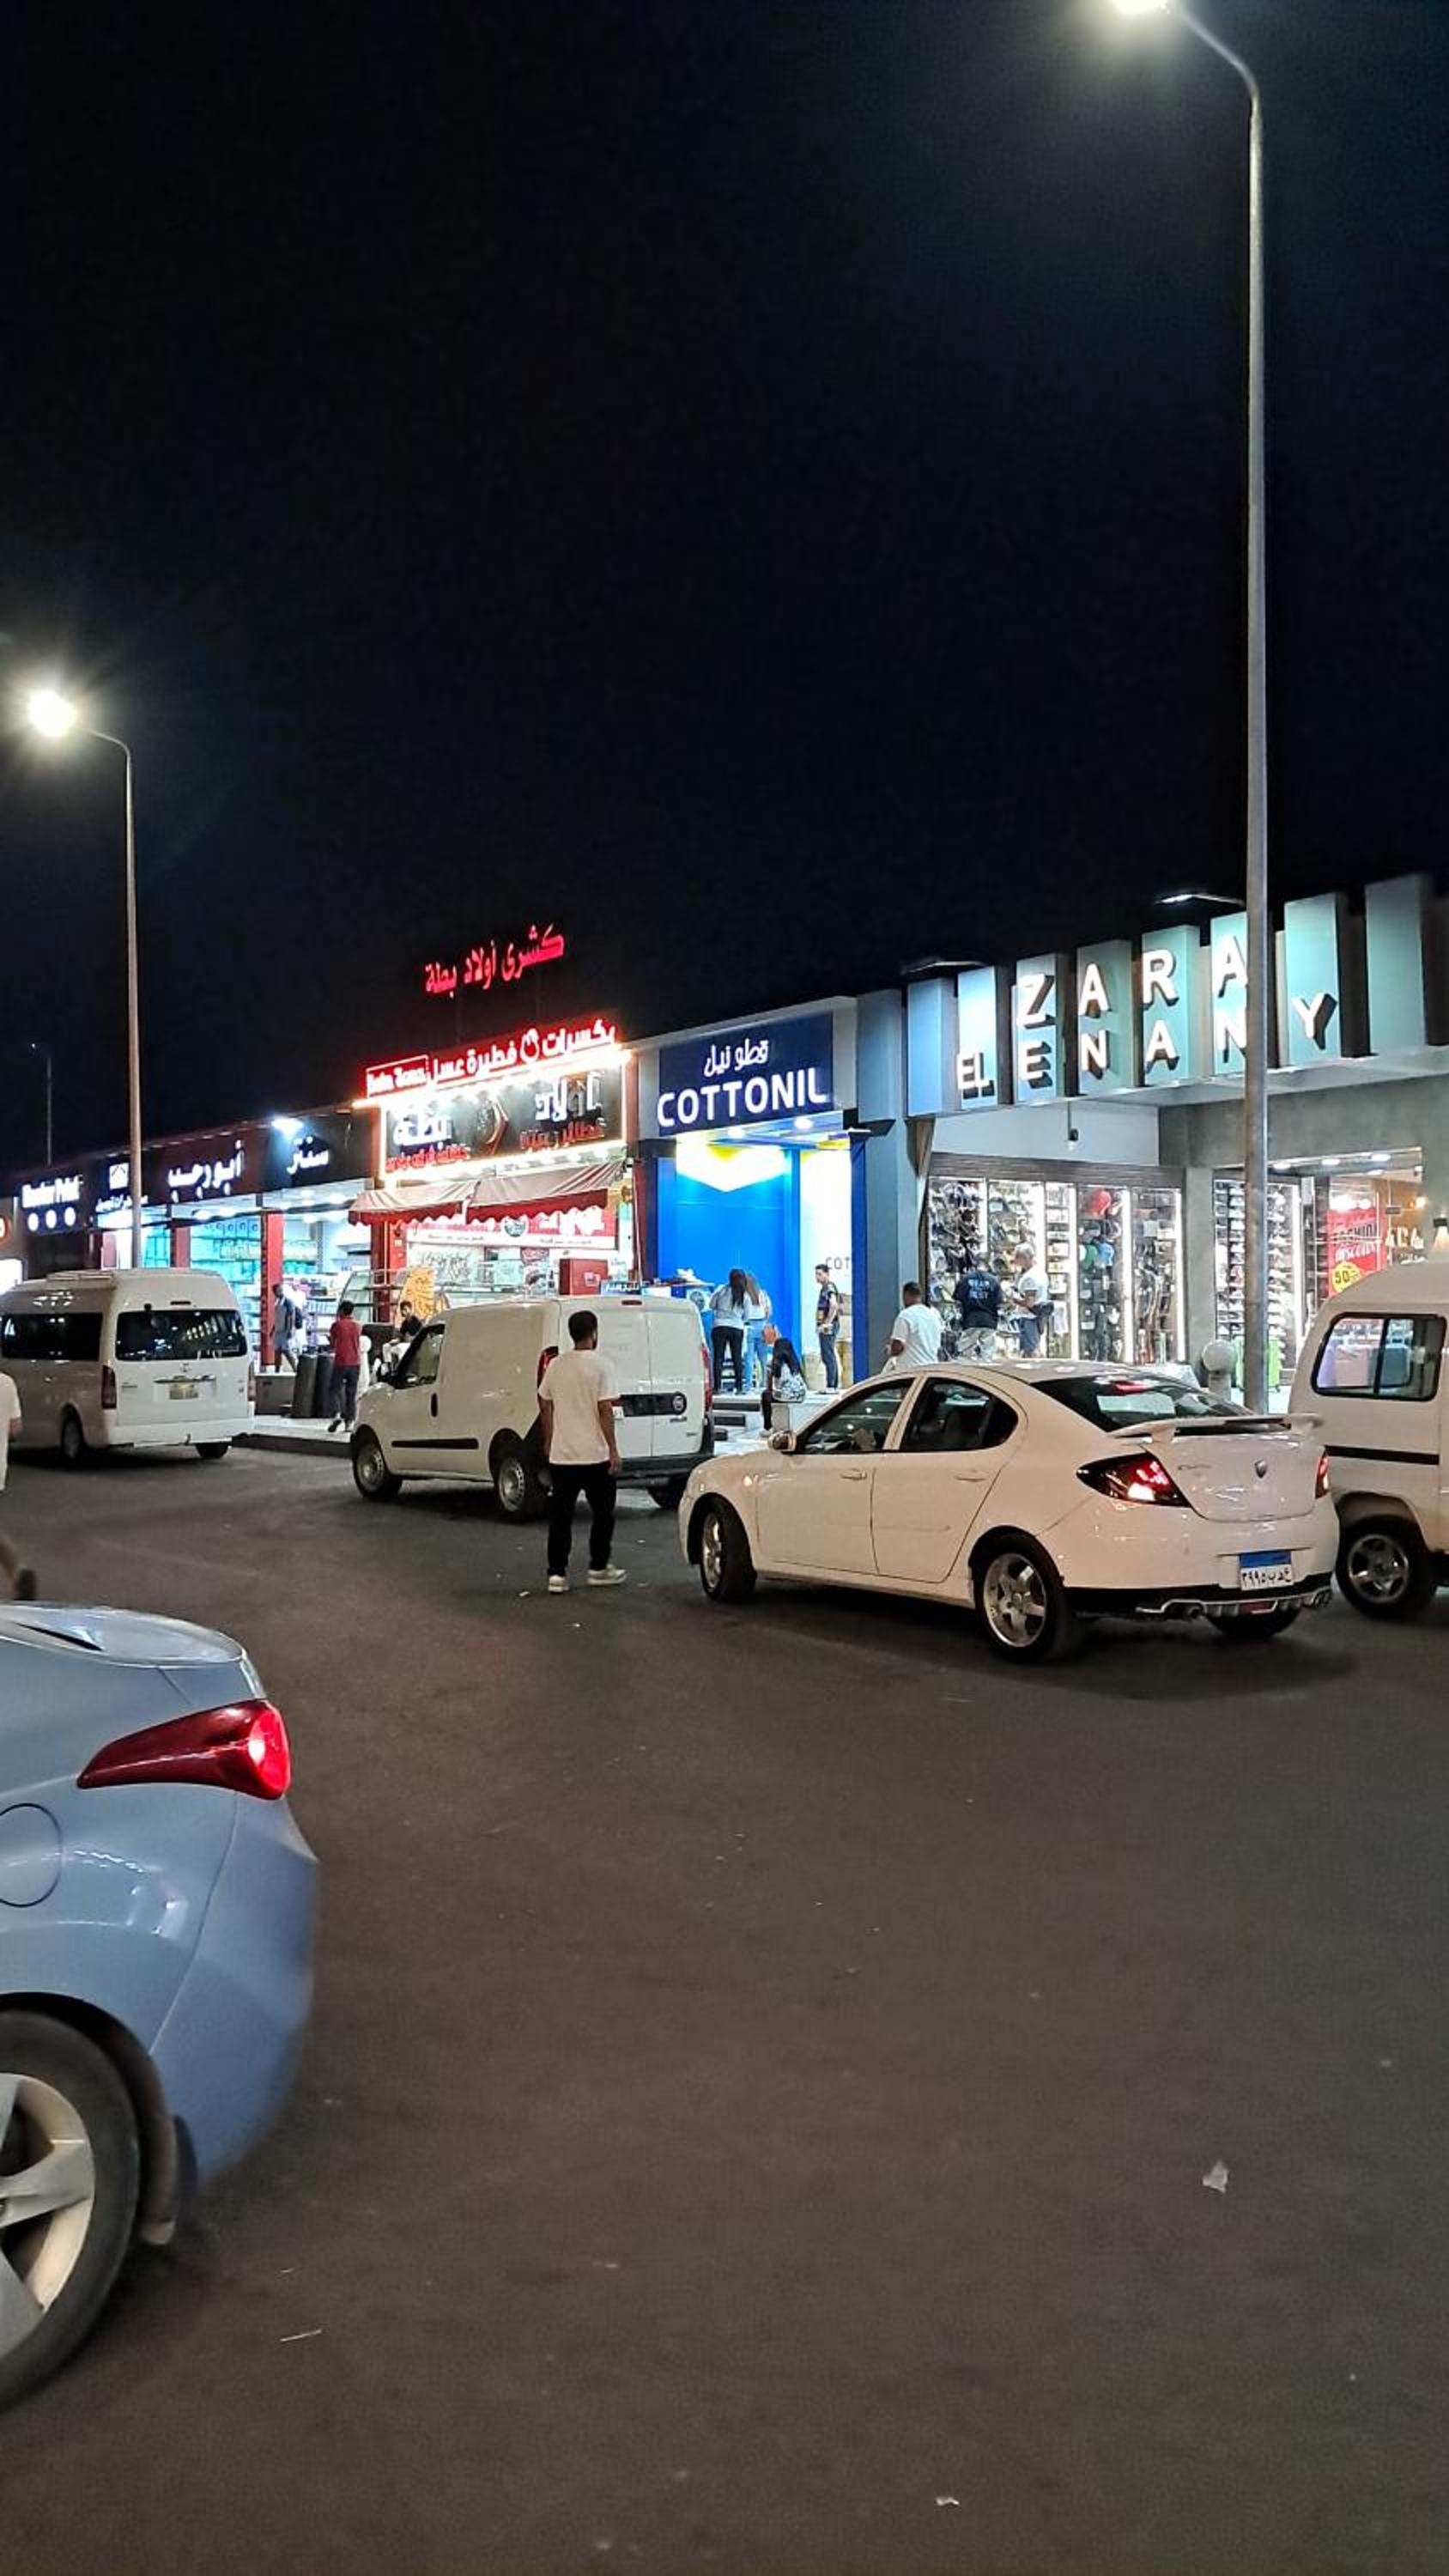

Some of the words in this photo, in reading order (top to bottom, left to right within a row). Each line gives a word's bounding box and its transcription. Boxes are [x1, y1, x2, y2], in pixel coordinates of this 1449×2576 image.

[464, 939, 498, 990] أولاد
[1016, 934, 1249, 1025] ZARA
[957, 1052, 993, 1090] EL
[1019, 992, 1334, 1081] ENANY
[657, 1067, 828, 1127] COTTONIL
